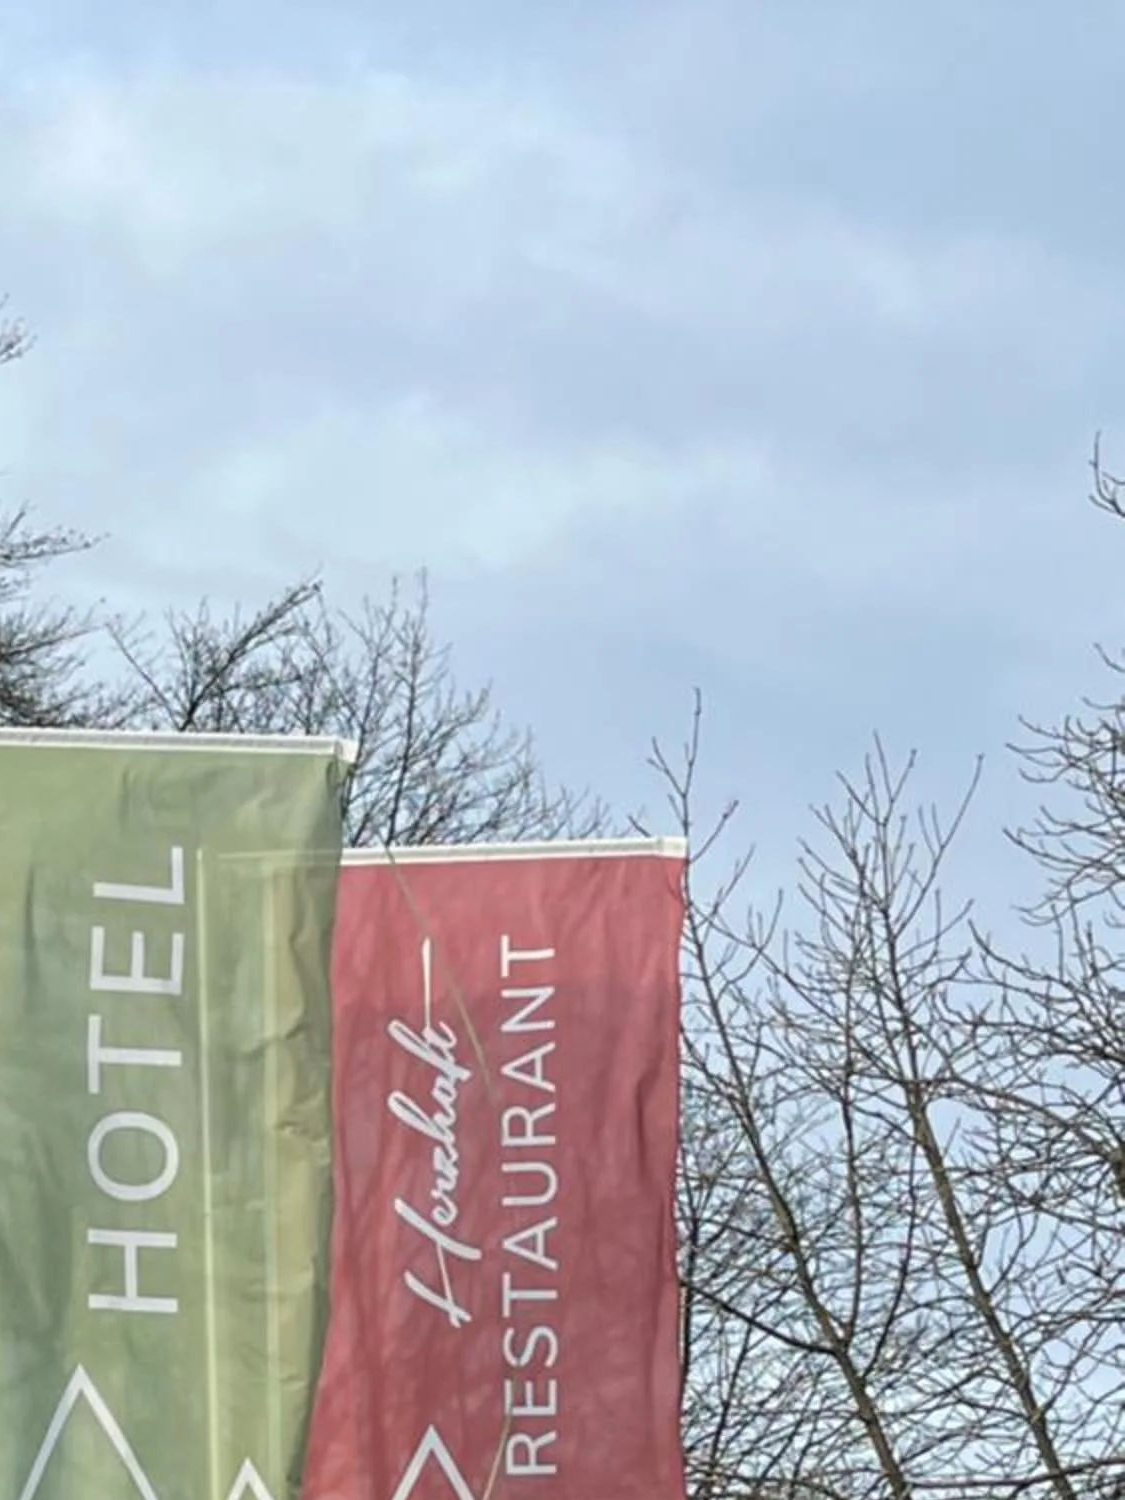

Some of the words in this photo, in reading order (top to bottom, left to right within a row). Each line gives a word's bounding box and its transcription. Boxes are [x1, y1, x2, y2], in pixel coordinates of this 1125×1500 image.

[87, 846, 186, 1314] HOTEL
[387, 937, 483, 1329] Herzhaft
[499, 935, 560, 1476] RESTAURANT
